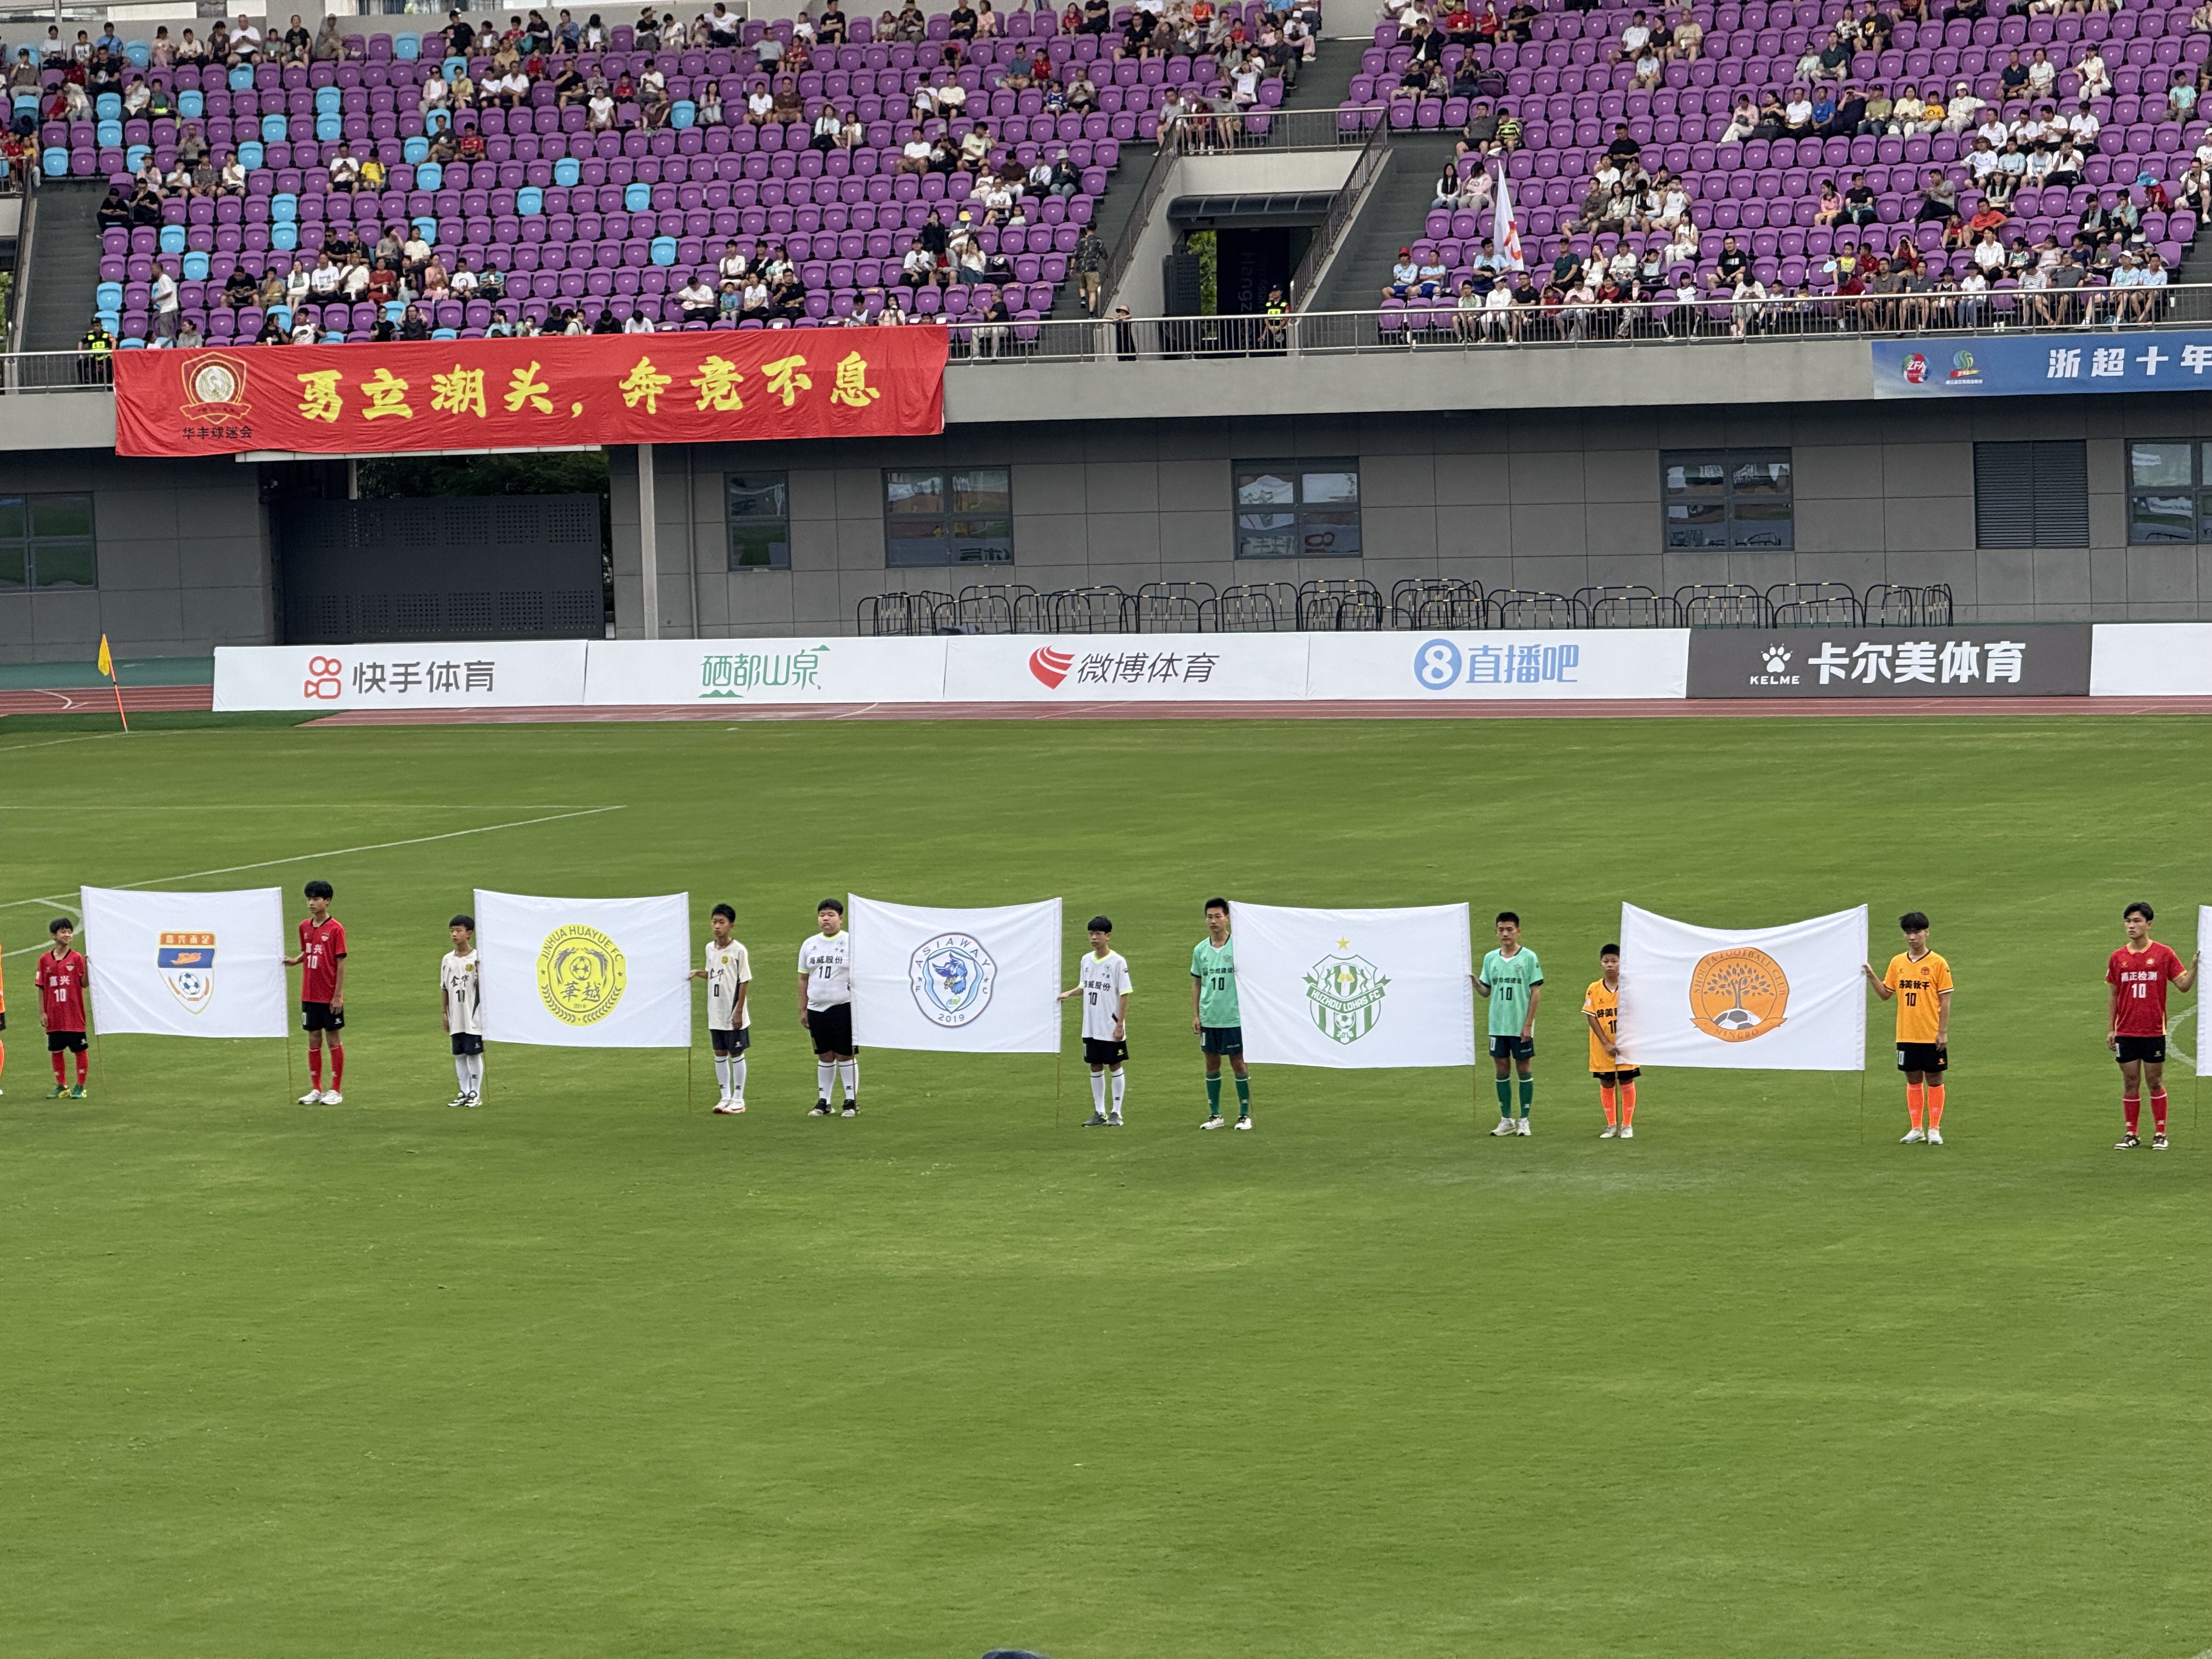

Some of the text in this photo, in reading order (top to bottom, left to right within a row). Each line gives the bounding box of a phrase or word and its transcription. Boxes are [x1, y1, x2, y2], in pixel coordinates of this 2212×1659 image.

[2047, 345, 2212, 379] 浙超十年
[183, 425, 252, 439] 华丰球迷会
[701, 650, 821, 691] 硒都山泉
[1077, 652, 1220, 684] 微博体育
[1465, 644, 1579, 684] 直播吧
[1808, 641, 2027, 685] 卡尔美体育
[352, 660, 495, 694] 快手体育
[1750, 675, 1799, 685] KELME
[541, 926, 623, 962] JINHUA HUAYUE FC
[915, 938, 991, 969] ASIAWAY
[307, 955, 318, 969] 10
[819, 966, 832, 979] 10
[1211, 977, 1224, 991] 10
[2131, 983, 2146, 998] 10
[54, 989, 66, 1002] 10
[1088, 991, 1097, 1006] 10
[1369, 990, 1380, 1001] FC
[1500, 987, 1512, 1001] 10
[1905, 992, 1917, 1007] 10
[938, 1013, 964, 1023] 2019
[1714, 1029, 1758, 1039] NINGBO
